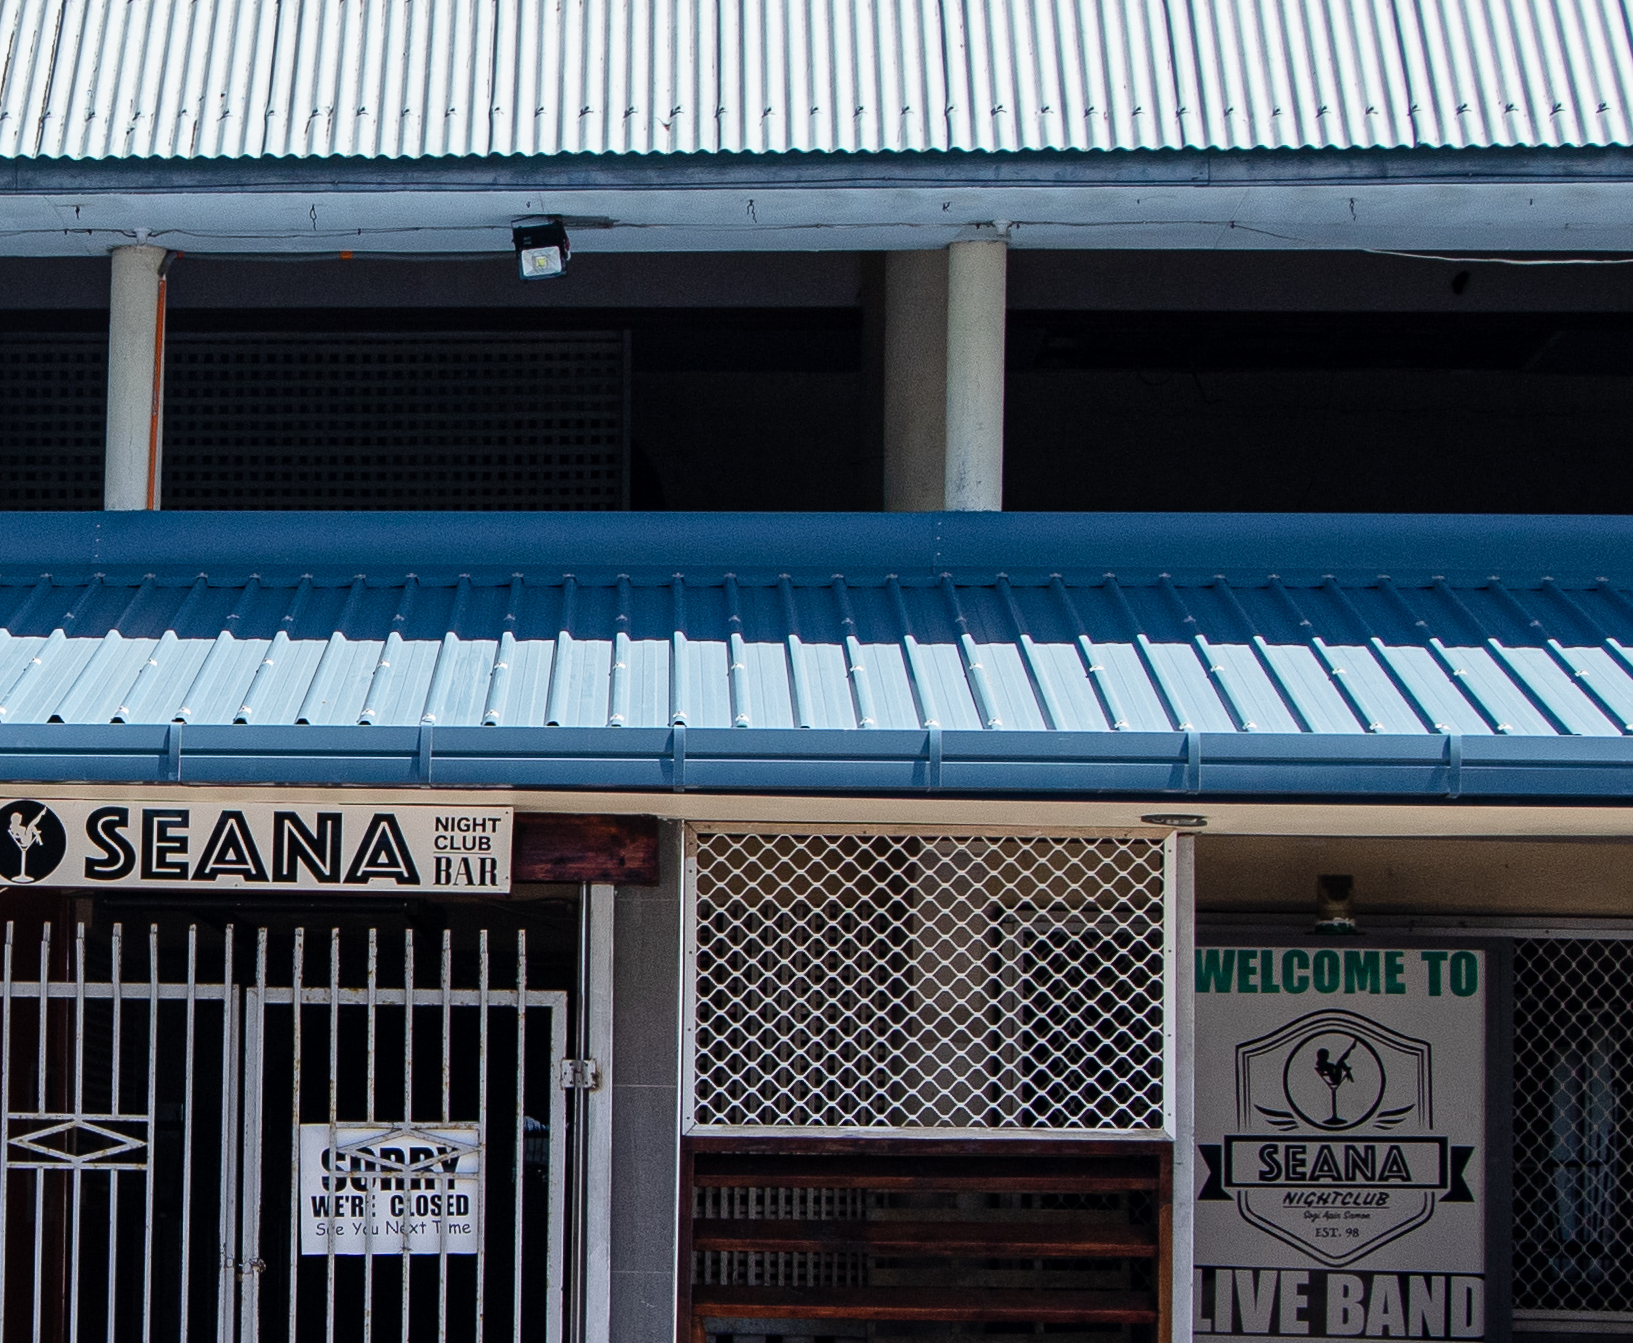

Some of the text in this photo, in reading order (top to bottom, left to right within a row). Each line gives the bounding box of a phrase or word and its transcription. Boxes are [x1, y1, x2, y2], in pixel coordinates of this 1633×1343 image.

[435, 817, 501, 834] NIGHT
[84, 807, 421, 886] SEANA
[434, 835, 492, 851] CLUB
[433, 857, 498, 886] BAR
[1195, 949, 1478, 997] WELCOME TO
[321, 1147, 460, 1191] SORRY
[1258, 1144, 1412, 1182] SEANA
[390, 1194, 469, 1217] COSED
[1282, 1191, 1390, 1207] NIGHTCLUB
[432, 1220, 471, 1235] Tme
[1315, 1227, 1360, 1238] EST. 98
[1193, 1268, 1484, 1338] LIVE BAND
